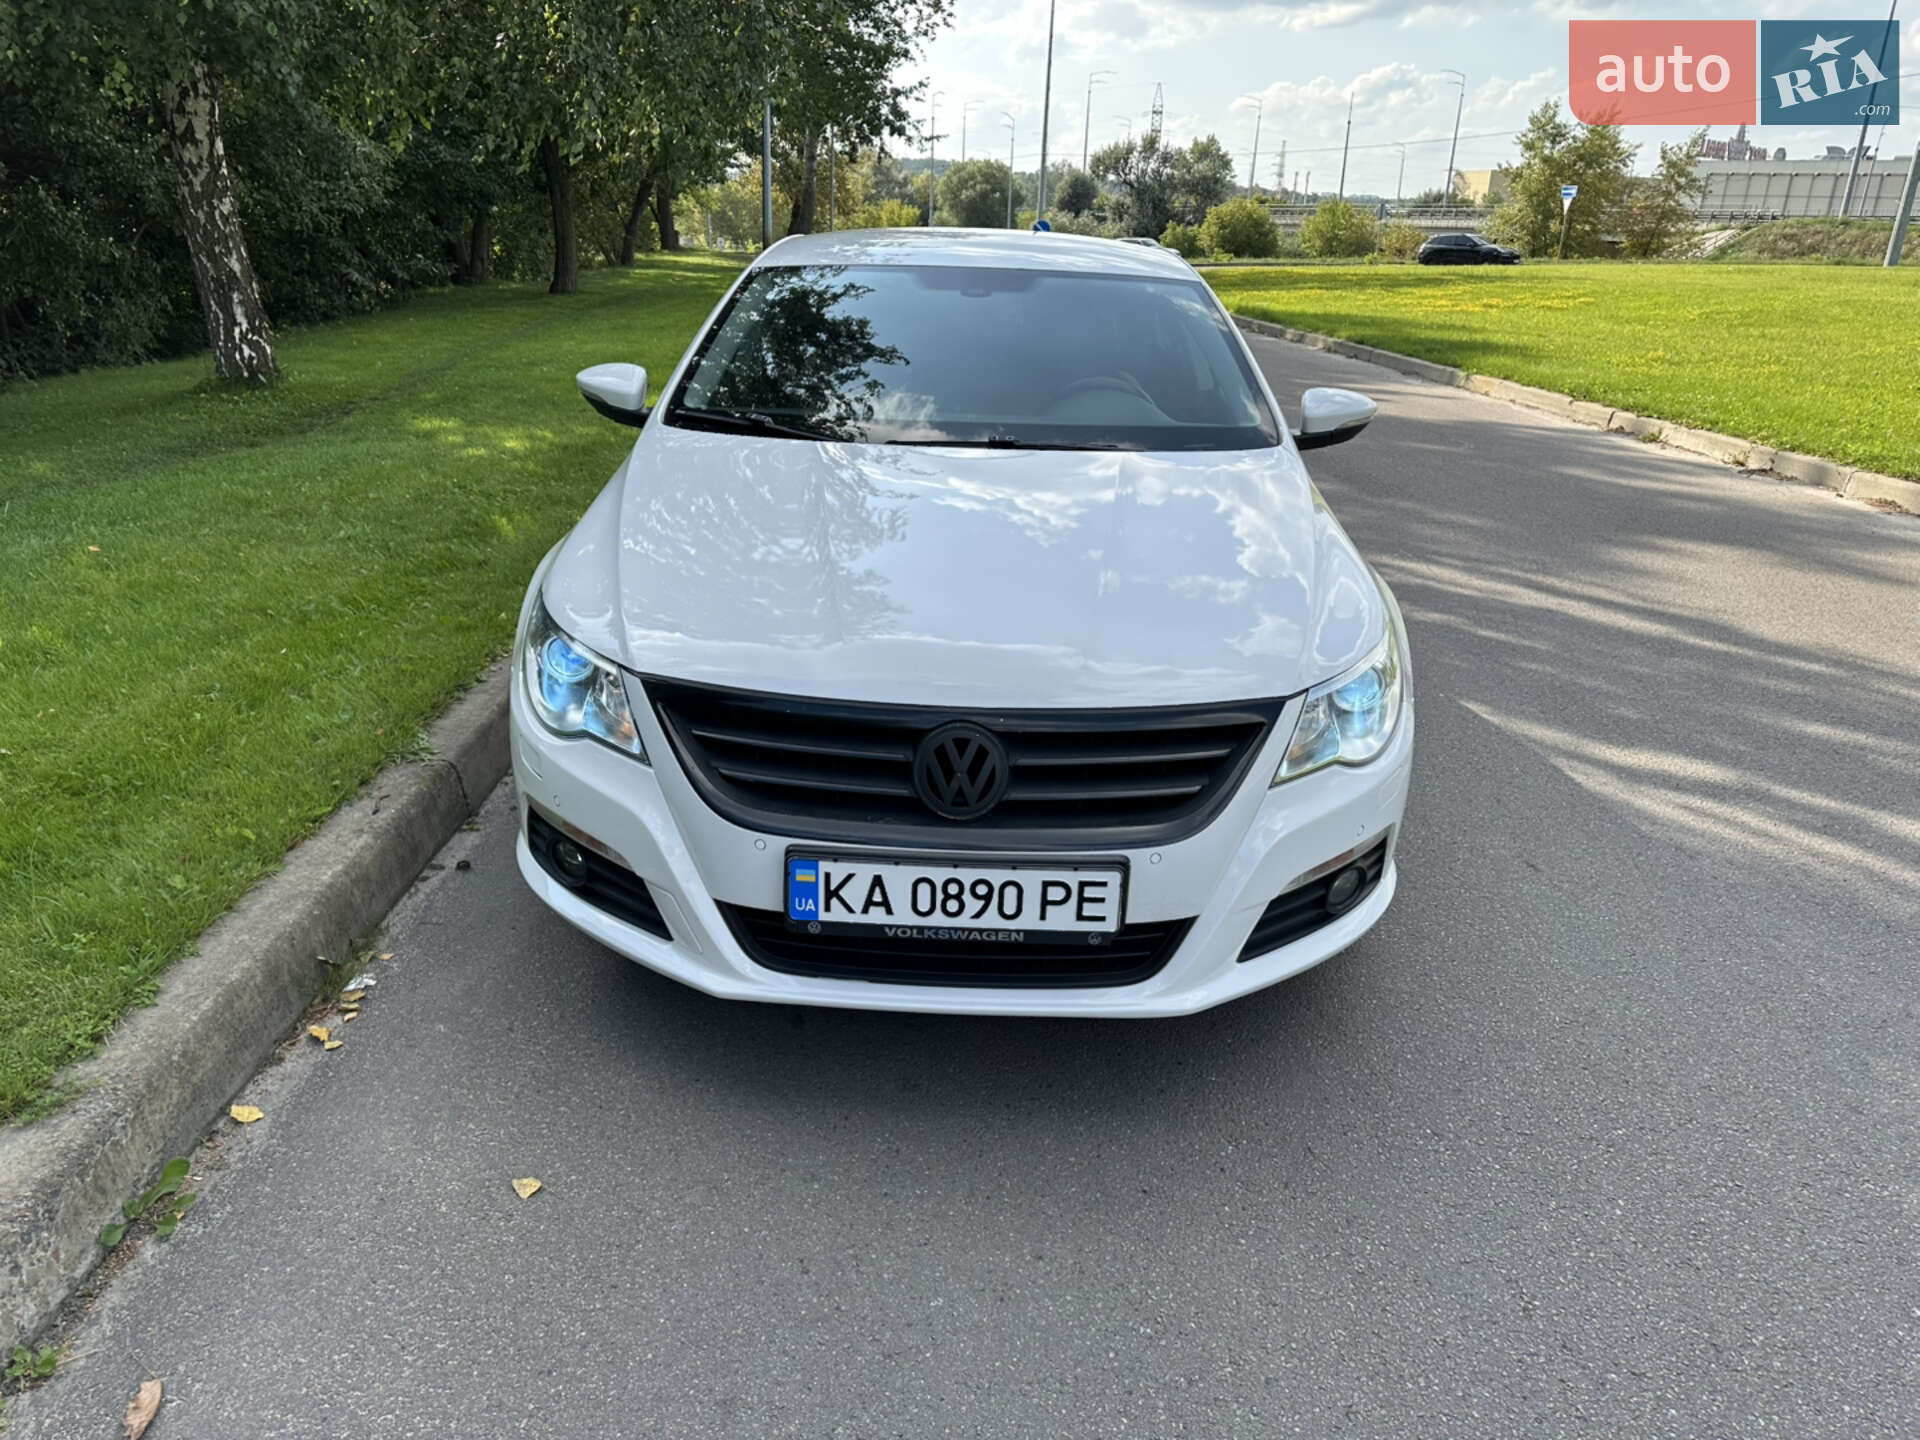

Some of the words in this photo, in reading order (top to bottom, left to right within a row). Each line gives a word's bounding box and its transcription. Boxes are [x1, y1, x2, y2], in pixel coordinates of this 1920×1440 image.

[795, 897, 815, 911] UA
[824, 872, 893, 914] KA
[911, 877, 1023, 920] 0890
[1040, 881, 1108, 921] PE
[885, 926, 1024, 941] VOLKSWAGEN
